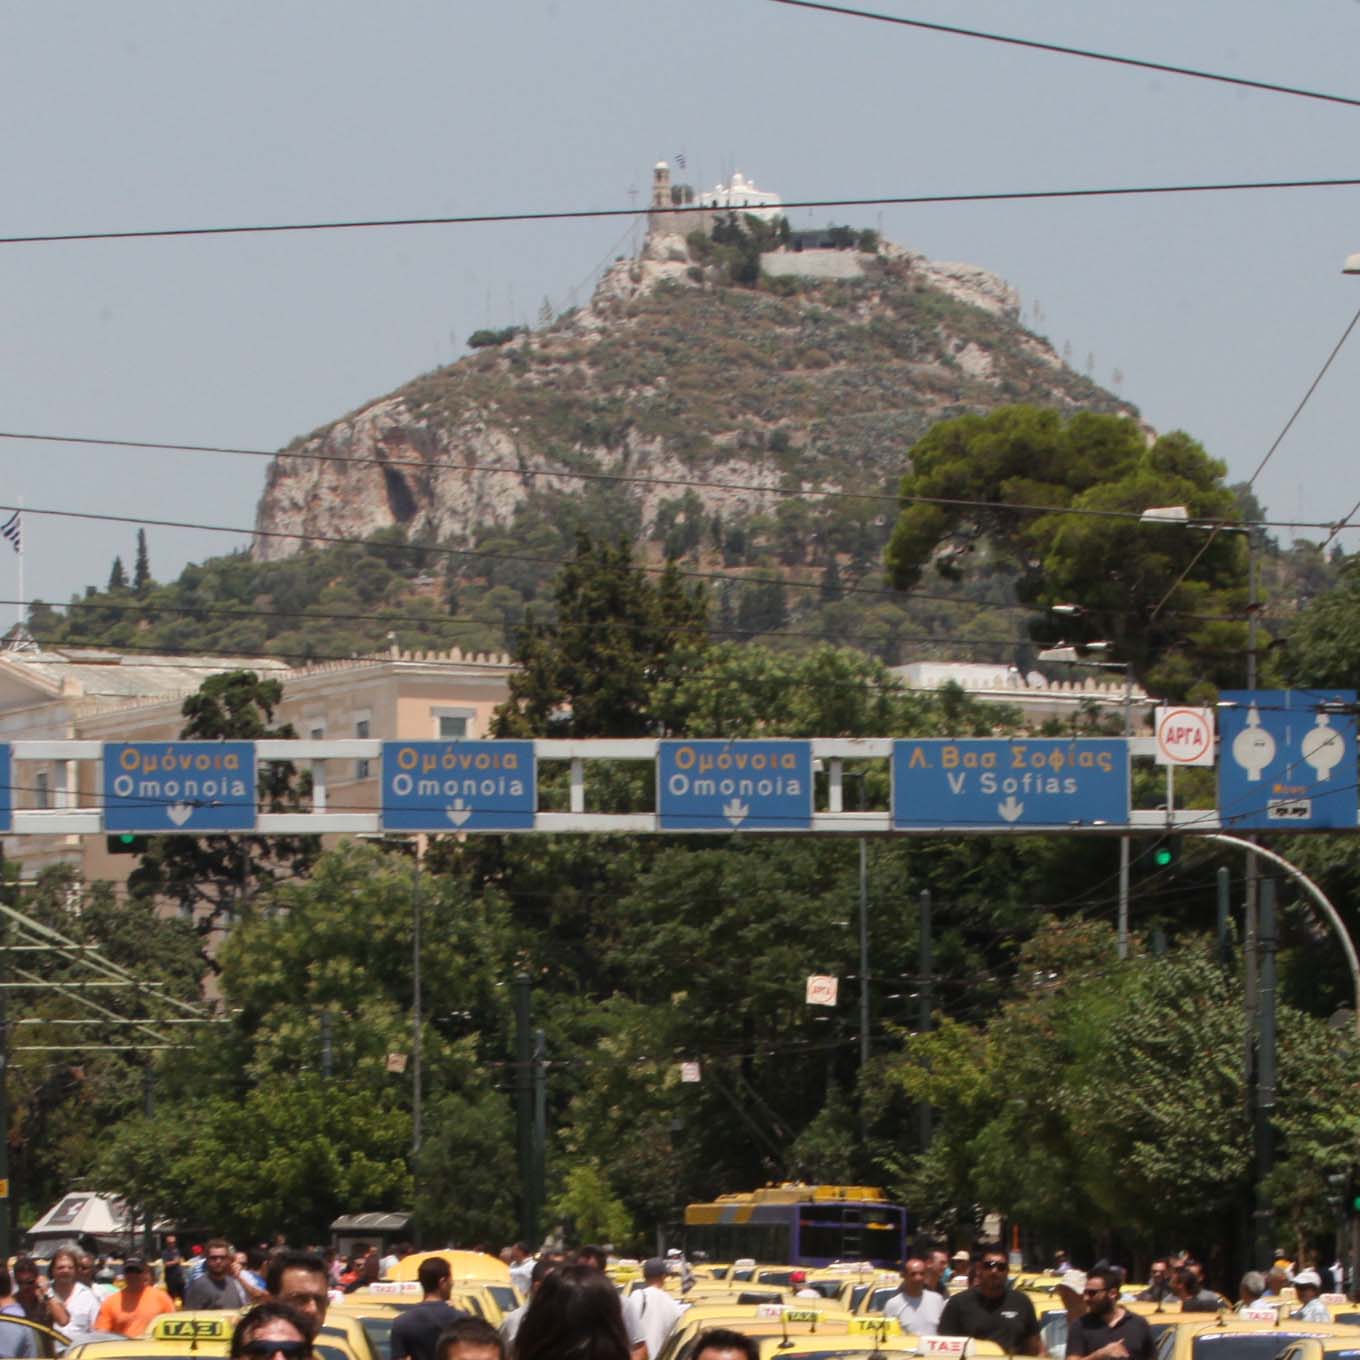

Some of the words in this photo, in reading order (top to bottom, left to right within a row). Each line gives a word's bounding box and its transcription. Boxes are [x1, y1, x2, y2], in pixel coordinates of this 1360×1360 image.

[1165, 726, 1203, 746] ΑΡΓΑ
[119, 746, 240, 773] Ομόνοια
[397, 746, 519, 773] Ομόνοια
[674, 745, 797, 774] Ομόνοια
[1010, 744, 1113, 772] Σοφίας
[113, 776, 246, 798] Omonoia
[392, 774, 524, 797] Omonoia
[668, 774, 802, 796] Omonoia
[980, 772, 1078, 794] Sofias
[927, 1339, 965, 1352] ΤΑΞ
